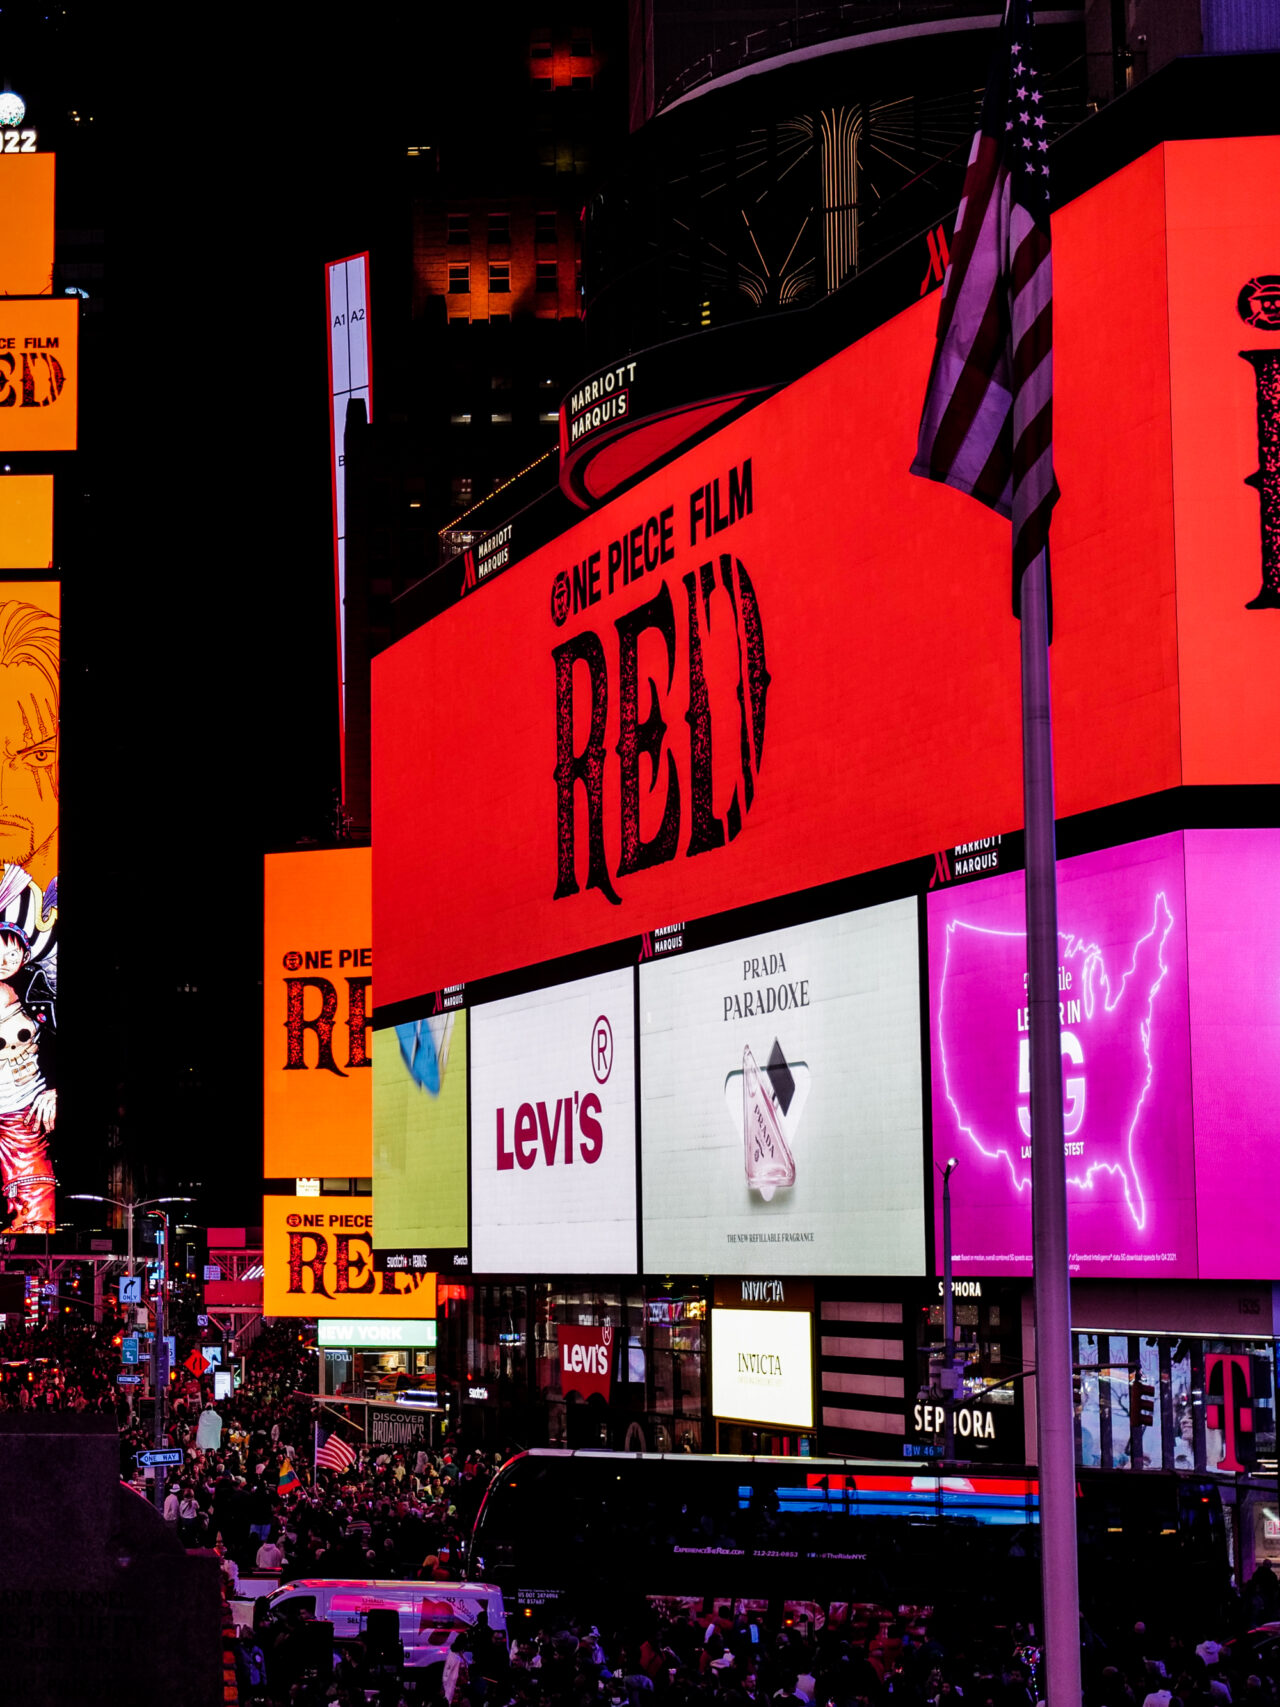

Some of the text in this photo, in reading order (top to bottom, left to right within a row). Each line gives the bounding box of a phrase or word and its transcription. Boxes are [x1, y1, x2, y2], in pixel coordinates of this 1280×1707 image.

[333, 307, 365, 328] A1 A2
[24, 337, 59, 349] FILM
[571, 362, 637, 415] MARRIOTT
[571, 395, 626, 442] MARQUIS
[608, 504, 674, 596] PIECE
[690, 457, 753, 547] FILM
[478, 524, 513, 558] MARRIOTT
[478, 547, 509, 579] MARQUIS
[551, 554, 771, 905] RED
[954, 834, 1003, 855] MARRIOTT
[954, 853, 998, 877] MARQUIS
[654, 922, 686, 937] MARRIOTT
[654, 935, 683, 953] MARQUIS
[743, 952, 786, 981] PRADA
[444, 994, 463, 1007] MARQUIS
[723, 980, 810, 1021] PARADOXE
[1068, 1000, 1081, 1025] IN
[754, 1104, 775, 1160] PRADA
[329, 1215, 372, 1227] PIECE
[727, 1234, 736, 1243] THE
[782, 1232, 814, 1242] FRAGRANCE
[741, 1280, 784, 1302] INVICTA
[938, 1281, 981, 1297] SPHORA
[358, 1326, 402, 1340] YORK
[738, 1353, 782, 1375] INVICTA
[373, 1412, 424, 1423] DISCOVER
[914, 1404, 995, 1439] SEPORA
[373, 1421, 424, 1444] BROADWAY'S
[913, 1446, 934, 1455] W 46
